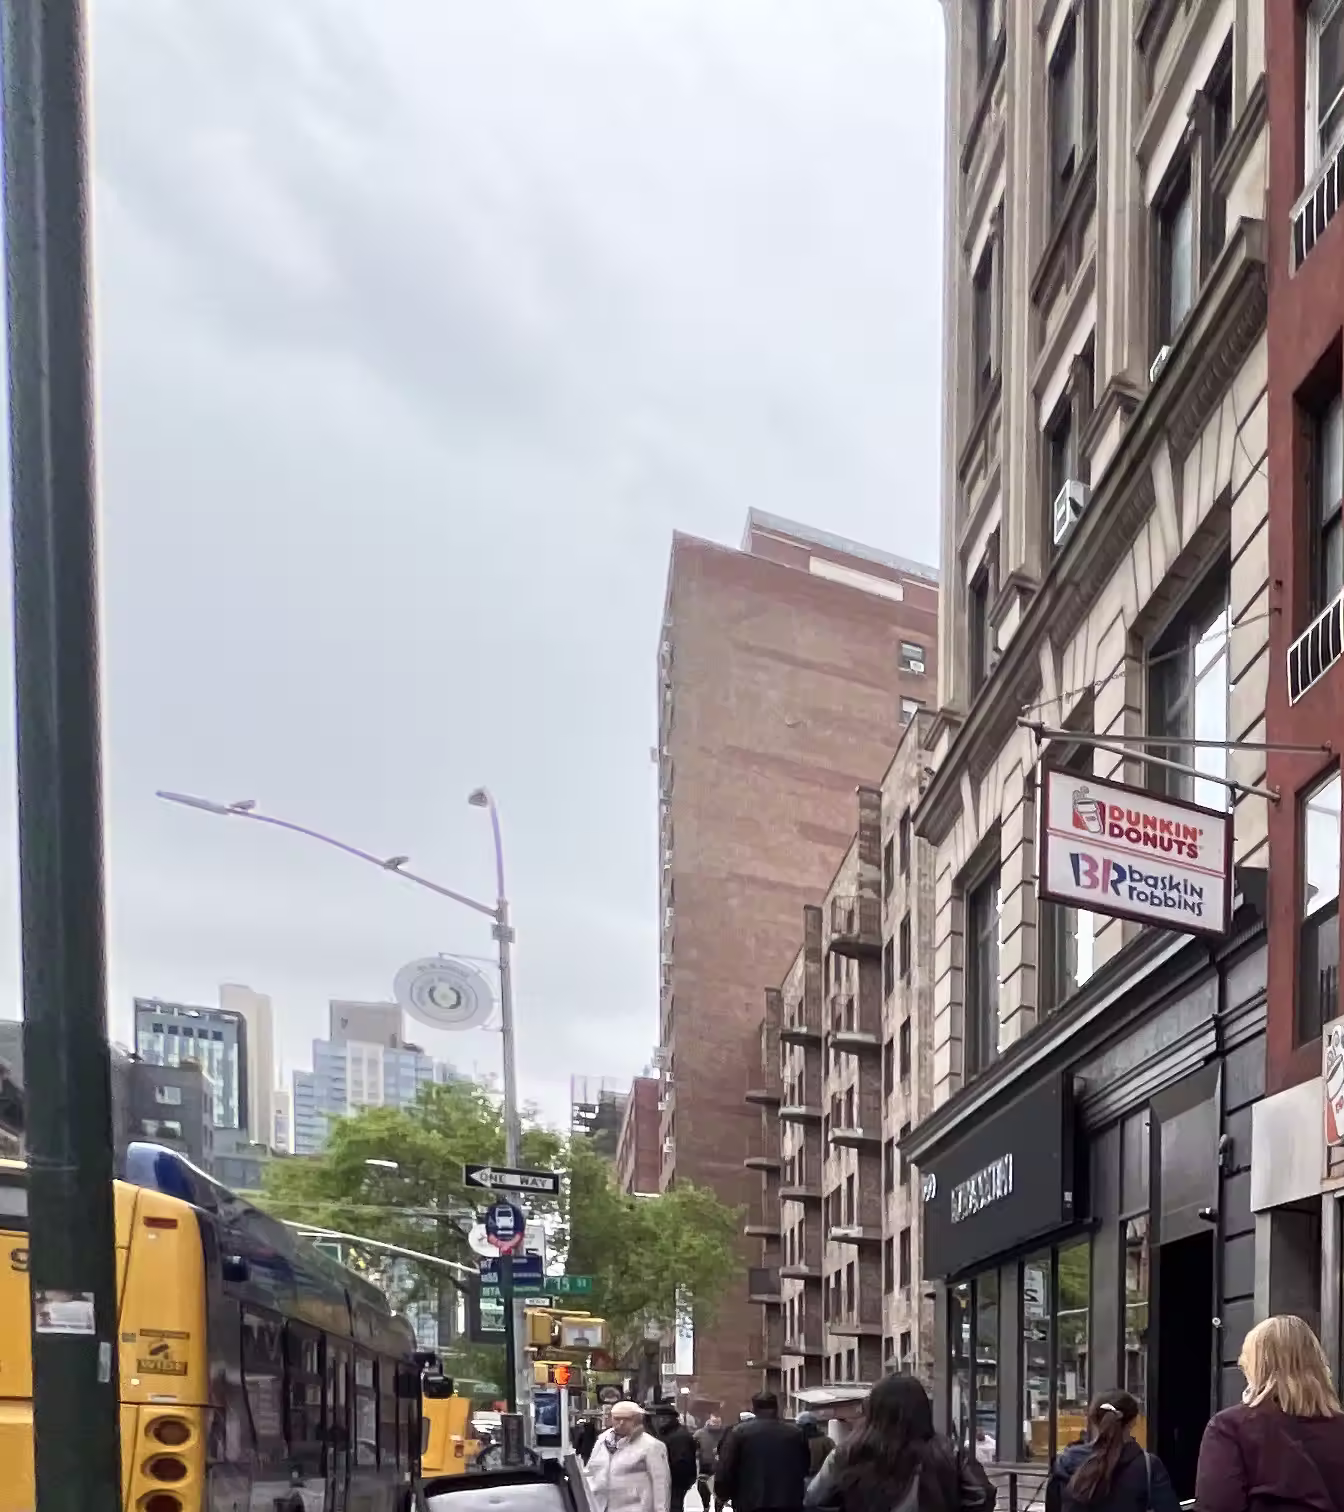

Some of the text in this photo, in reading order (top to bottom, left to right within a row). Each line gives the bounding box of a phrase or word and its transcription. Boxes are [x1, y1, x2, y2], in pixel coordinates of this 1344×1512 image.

[1109, 805, 1203, 841] DUNKIN'
[1109, 822, 1198, 859] DONUTS
[1070, 852, 1127, 896] BR
[480, 1172, 548, 1186] ONE WAY
